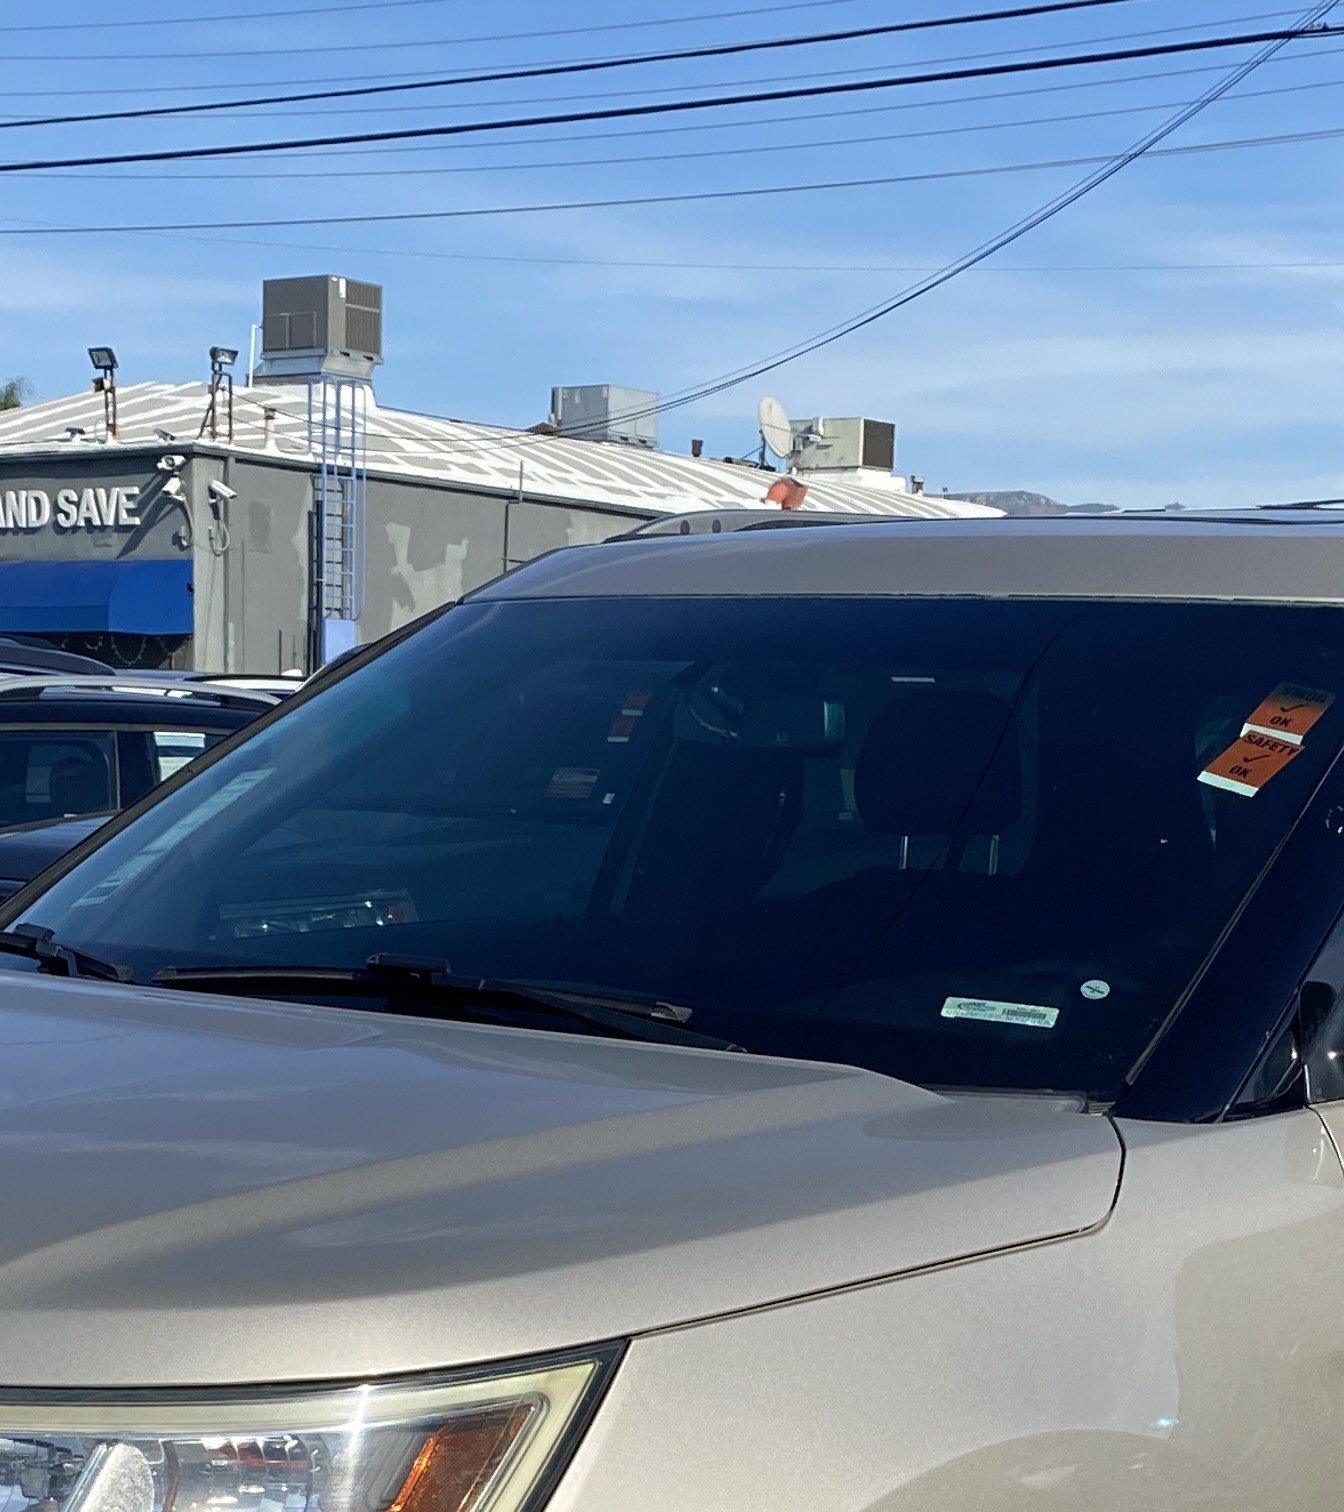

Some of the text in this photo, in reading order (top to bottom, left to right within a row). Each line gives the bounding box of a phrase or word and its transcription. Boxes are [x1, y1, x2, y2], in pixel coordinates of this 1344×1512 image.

[57, 486, 141, 528] SAVE
[1270, 716, 1292, 727] OK
[1245, 734, 1300, 757] SAFETY
[1229, 766, 1252, 779] OK
